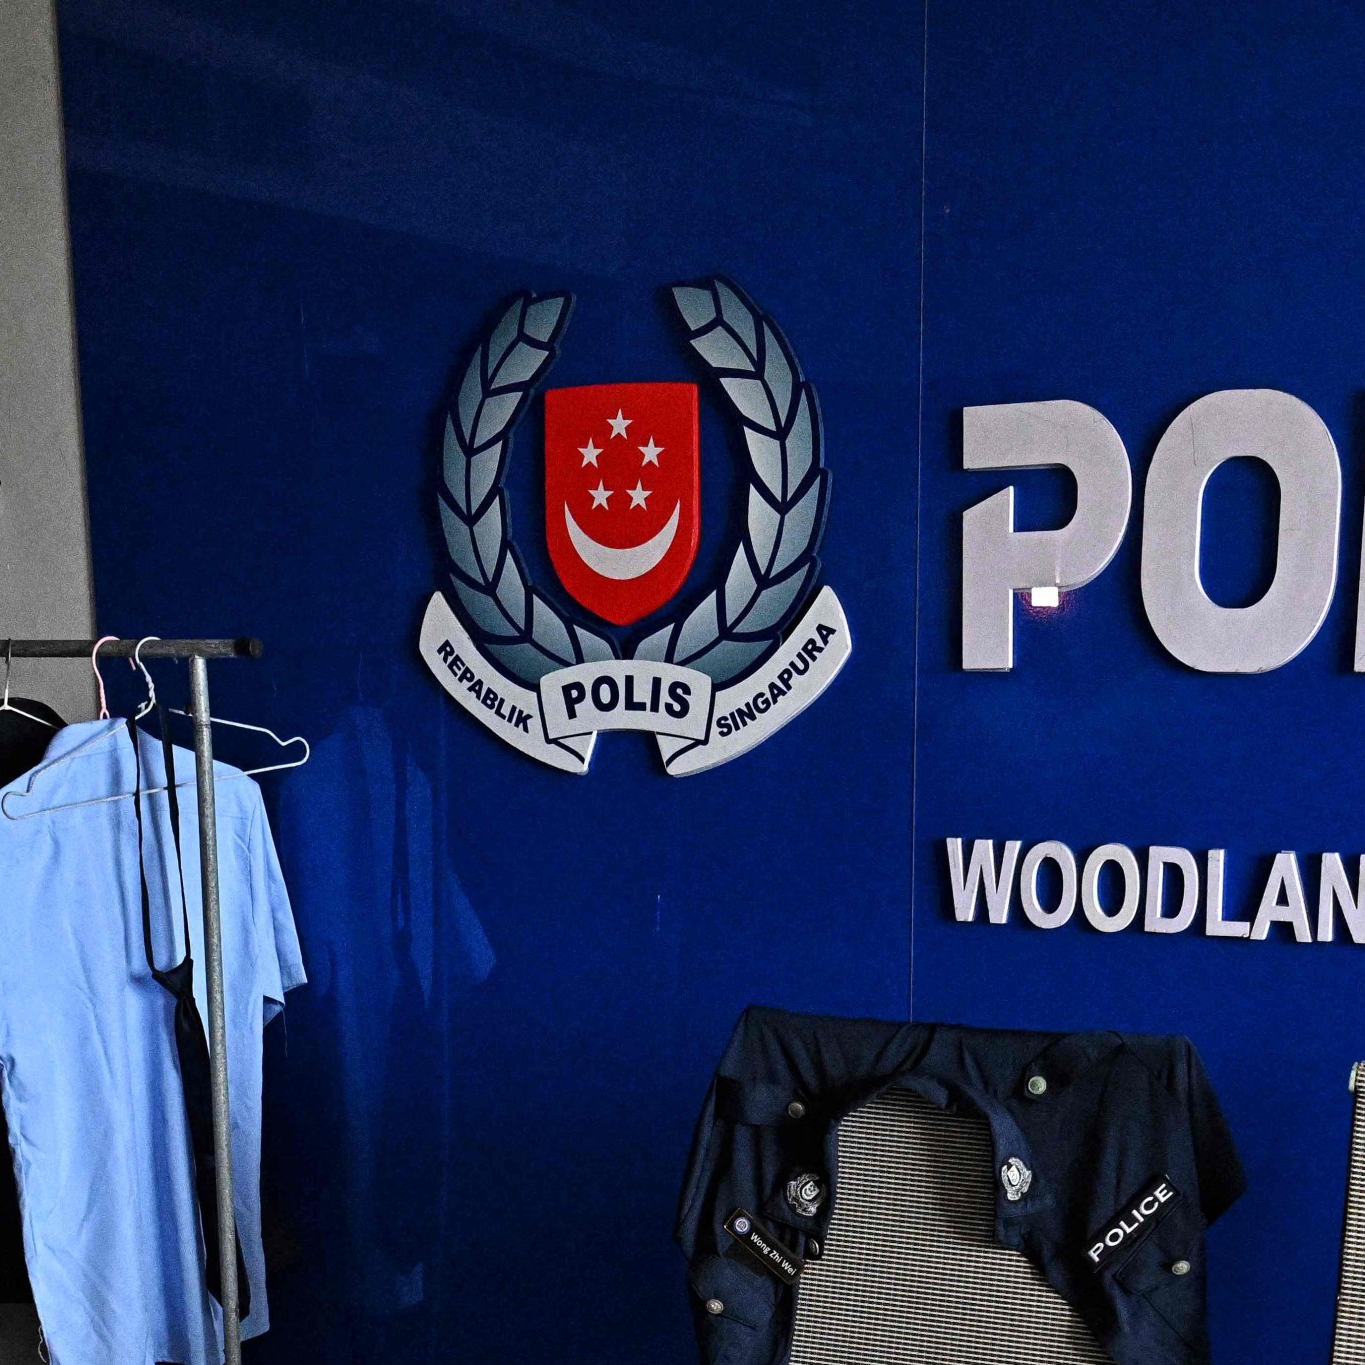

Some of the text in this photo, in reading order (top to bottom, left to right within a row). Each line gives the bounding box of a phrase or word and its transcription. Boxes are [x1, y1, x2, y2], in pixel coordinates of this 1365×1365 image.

[436, 638, 534, 734] REPABLIK
[561, 674, 692, 720] POLIS
[715, 622, 837, 737] SINGAPURA
[750, 1232, 797, 1275] Wong Zhi Wei
[1088, 1183, 1174, 1262] POLICE
